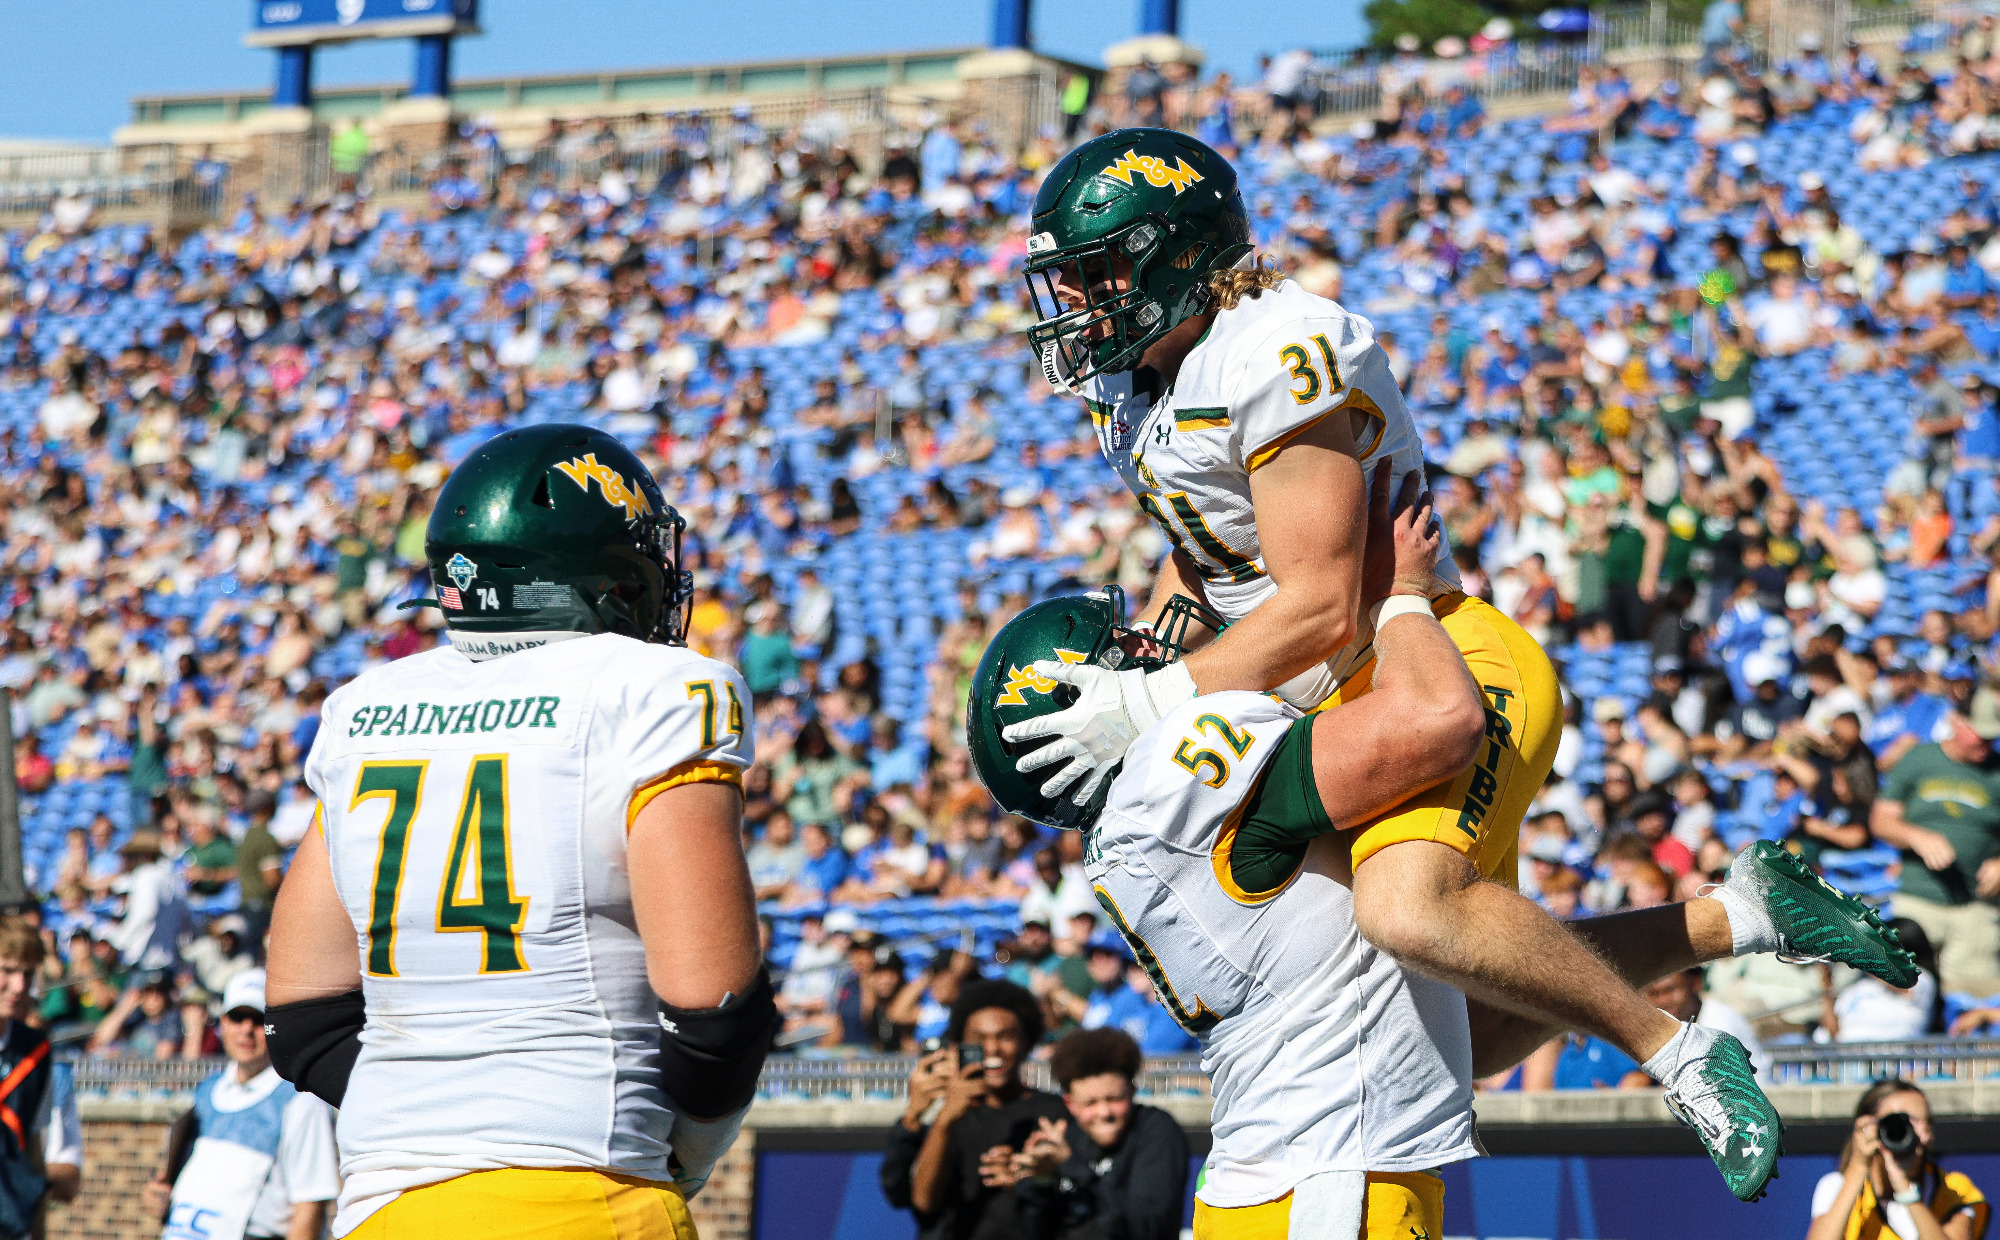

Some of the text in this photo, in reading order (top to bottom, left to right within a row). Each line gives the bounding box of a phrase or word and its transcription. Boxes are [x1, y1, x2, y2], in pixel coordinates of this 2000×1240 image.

[1100, 149, 1204, 196] W&M
[1278, 333, 1346, 405] 31
[552, 452, 652, 522] W&M
[450, 566, 471, 575] FCS
[476, 587, 500, 611] 74
[349, 696, 560, 738] SPAINHOUR
[684, 679, 745, 750] 74
[1171, 713, 1256, 789] 52
[1456, 684, 1514, 843] TRIBE
[348, 753, 532, 977] 74
